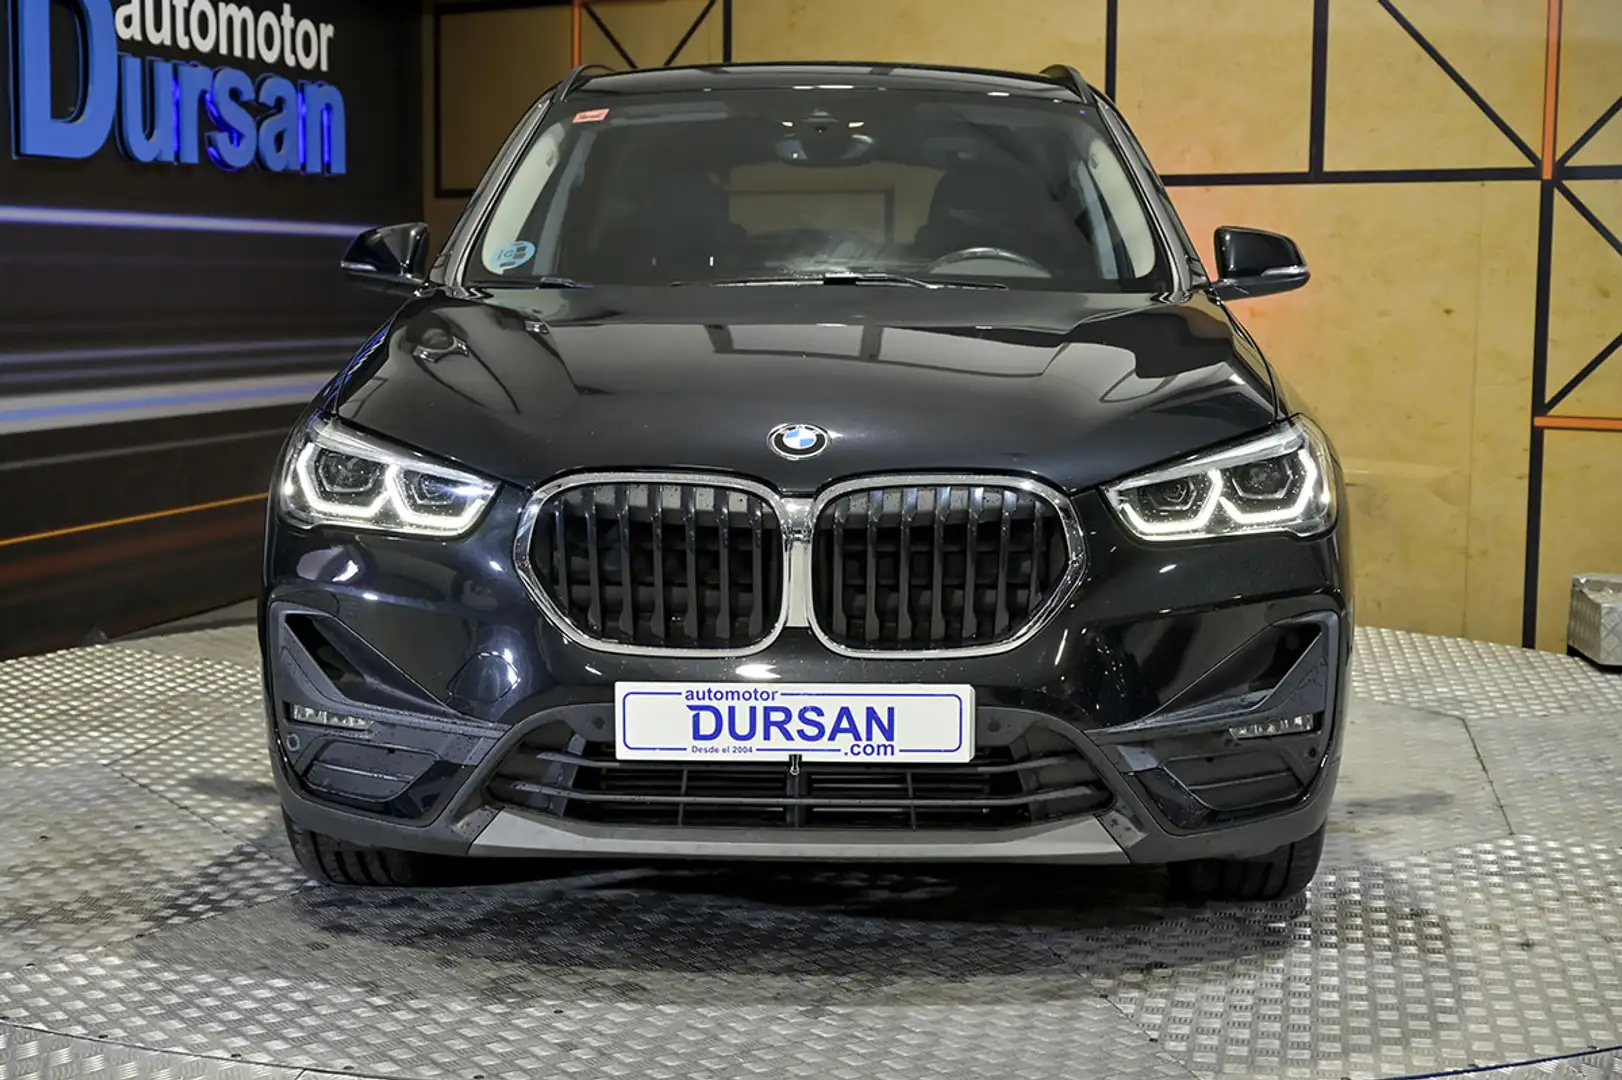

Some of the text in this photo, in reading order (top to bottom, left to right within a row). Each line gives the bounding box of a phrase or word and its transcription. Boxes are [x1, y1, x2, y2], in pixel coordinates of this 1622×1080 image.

[115, 0, 335, 72] automotor
[10, 0, 347, 176] Dursan
[685, 687, 778, 701] automotor
[686, 705, 895, 742] DURSAN
[691, 745, 753, 754] Desde el 2004
[844, 743, 895, 756] .com
